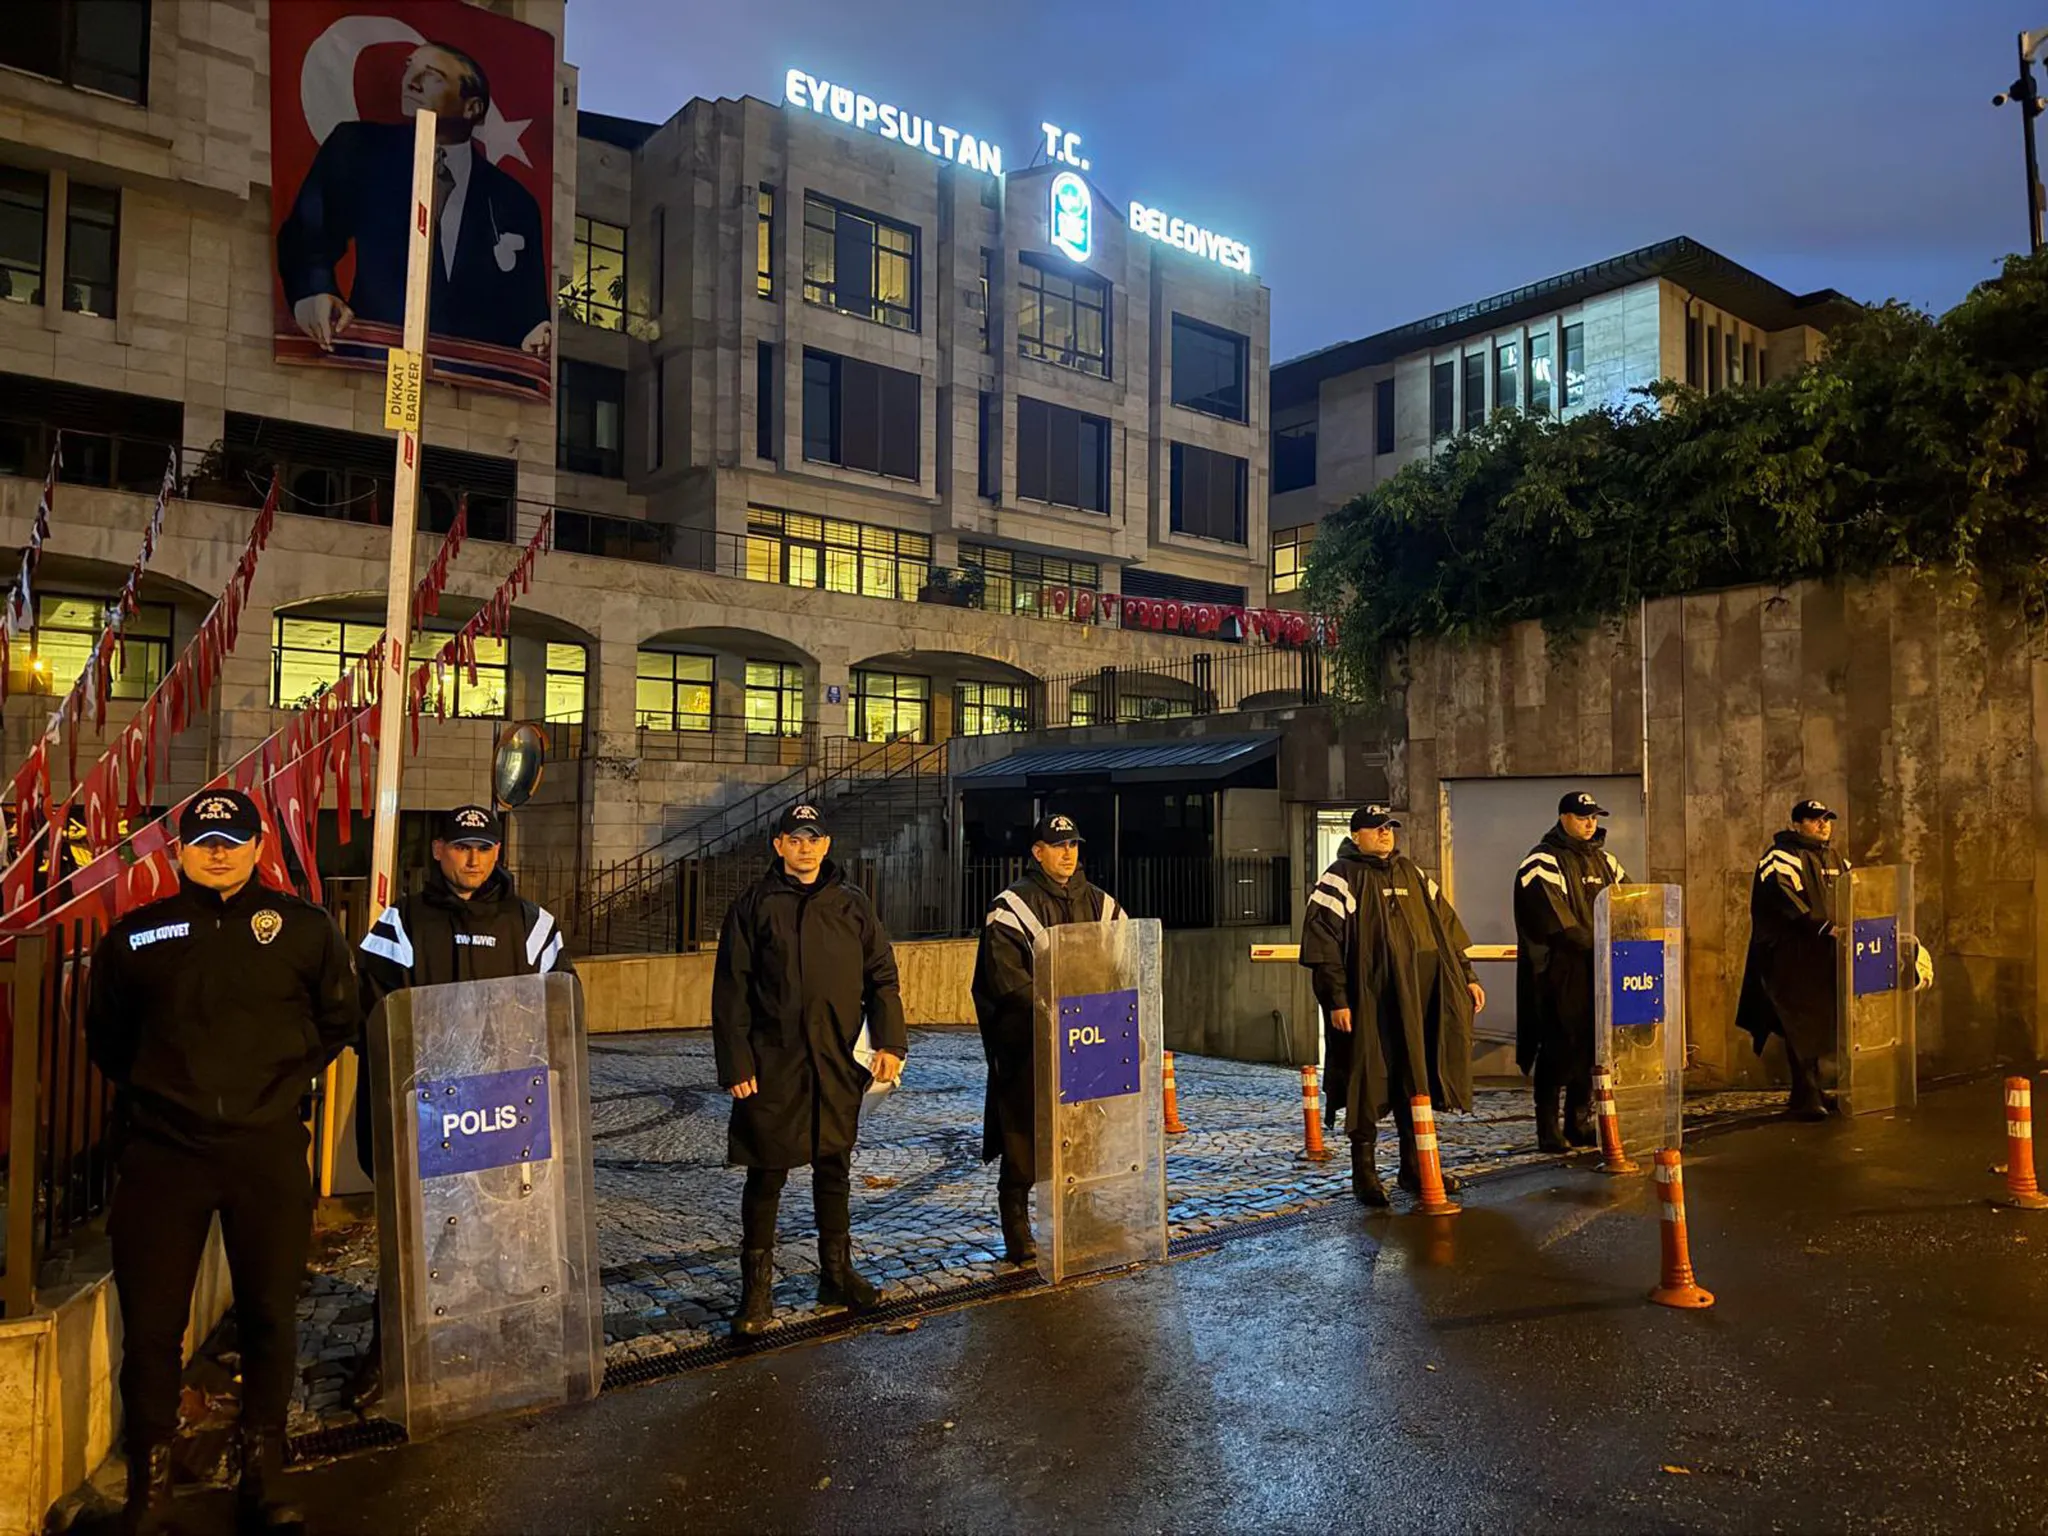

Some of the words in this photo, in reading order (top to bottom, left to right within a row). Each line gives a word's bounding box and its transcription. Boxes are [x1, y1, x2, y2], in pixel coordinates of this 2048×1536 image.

[785, 68, 1002, 177] EYÜPSULTAN
[1041, 121, 1090, 171] T.C.
[388, 364, 405, 415] DİKKAT
[405, 362, 420, 422] BARİYER
